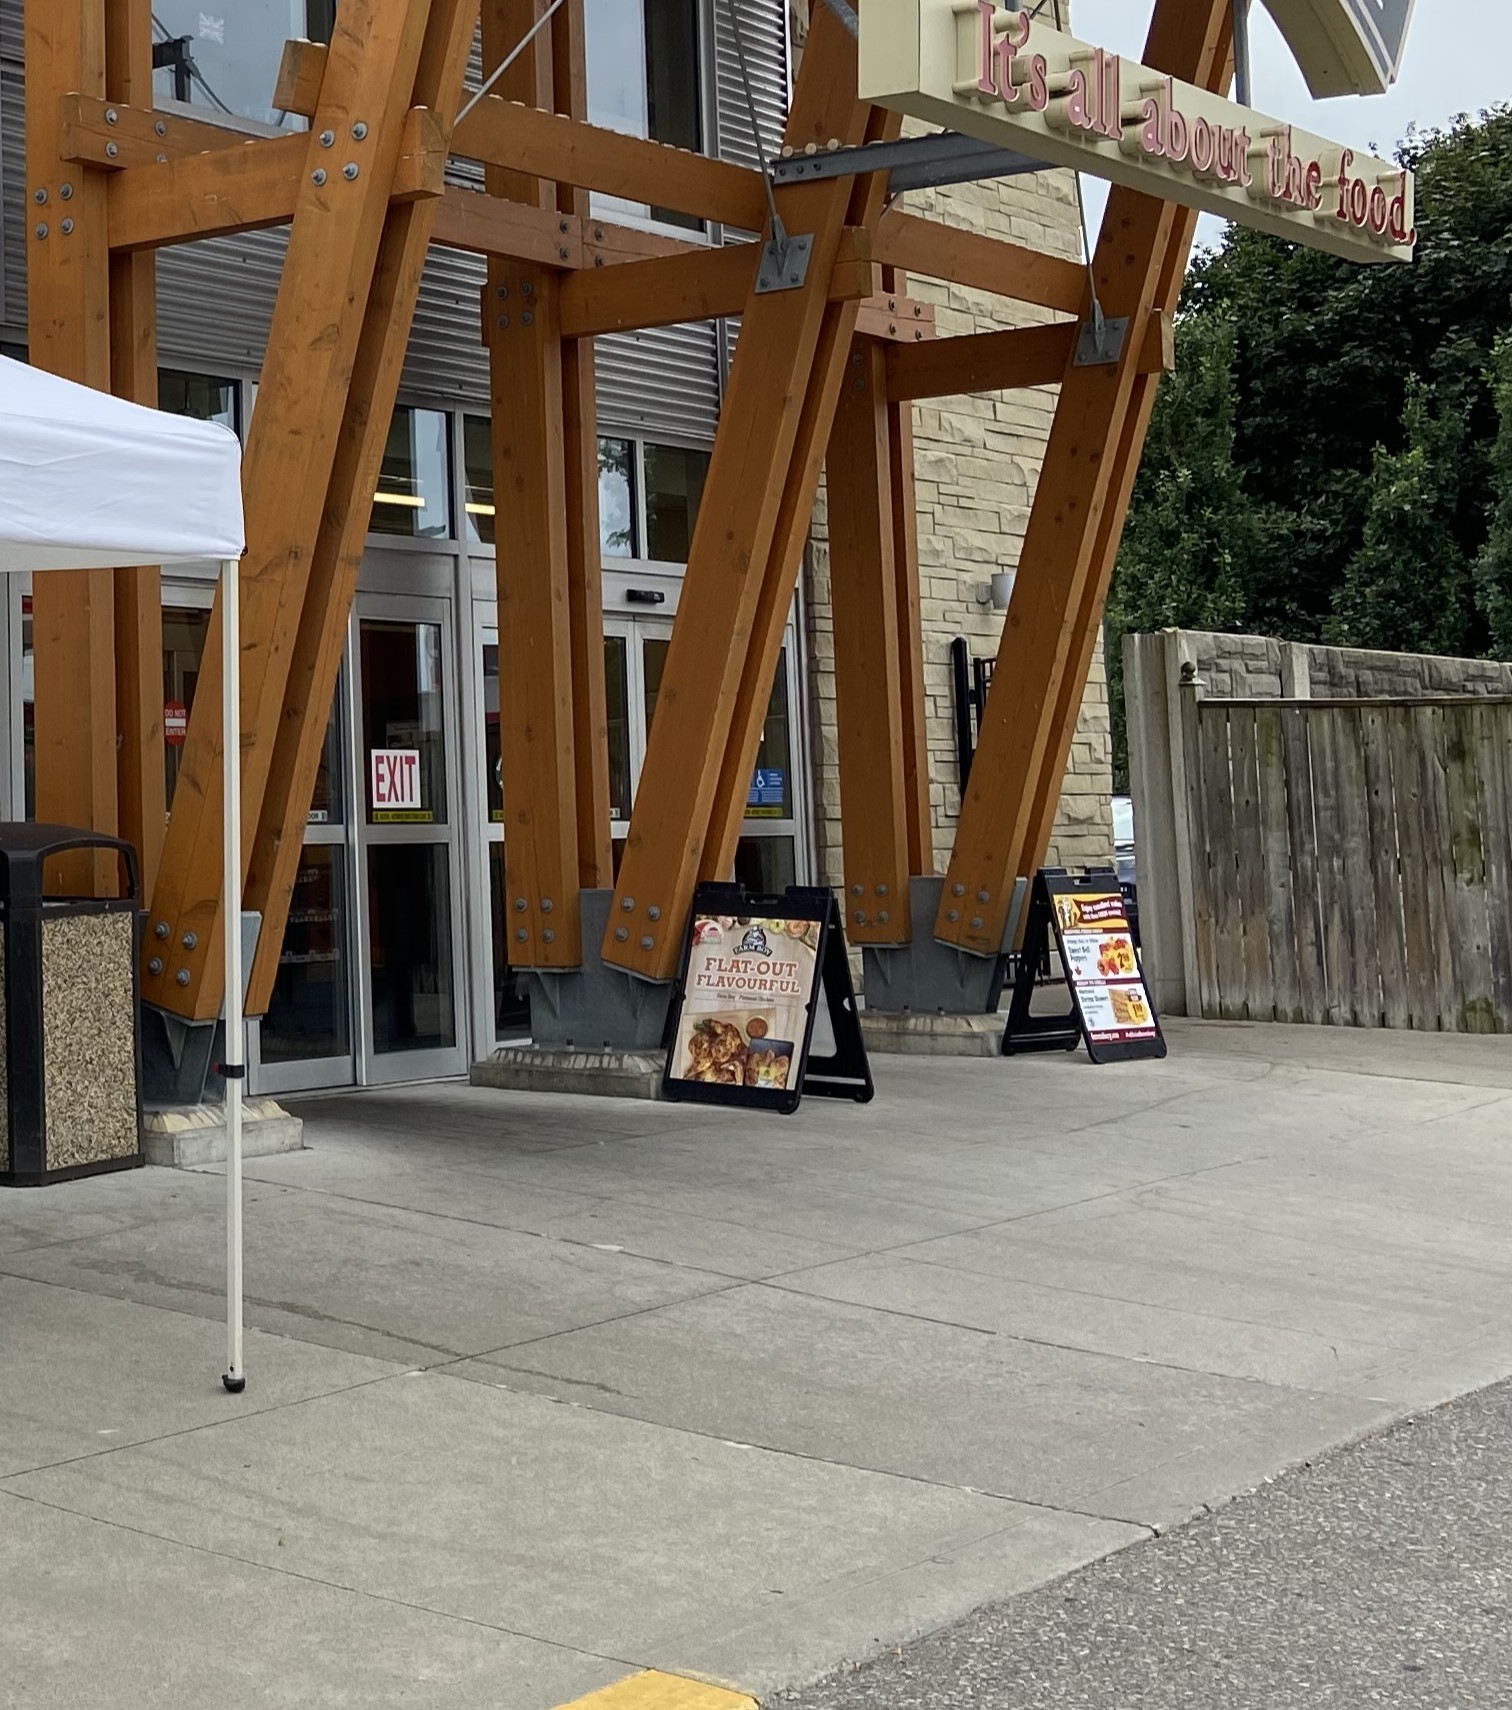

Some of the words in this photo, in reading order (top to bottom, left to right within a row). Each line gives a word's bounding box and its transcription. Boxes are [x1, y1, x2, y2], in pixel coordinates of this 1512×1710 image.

[978, 0, 1049, 112] It's
[1068, 47, 1123, 141] all
[1140, 75, 1254, 187] about
[1266, 123, 1324, 212] the
[165, 709, 174, 717] DO
[174, 709, 186, 717] NOT
[165, 727, 186, 736] ENTER
[375, 755, 416, 802] EXIT
[734, 945, 755, 955] FARM
[705, 957, 797, 977] FLAT-OUT
[696, 974, 800, 993] FLAVOURFUL
